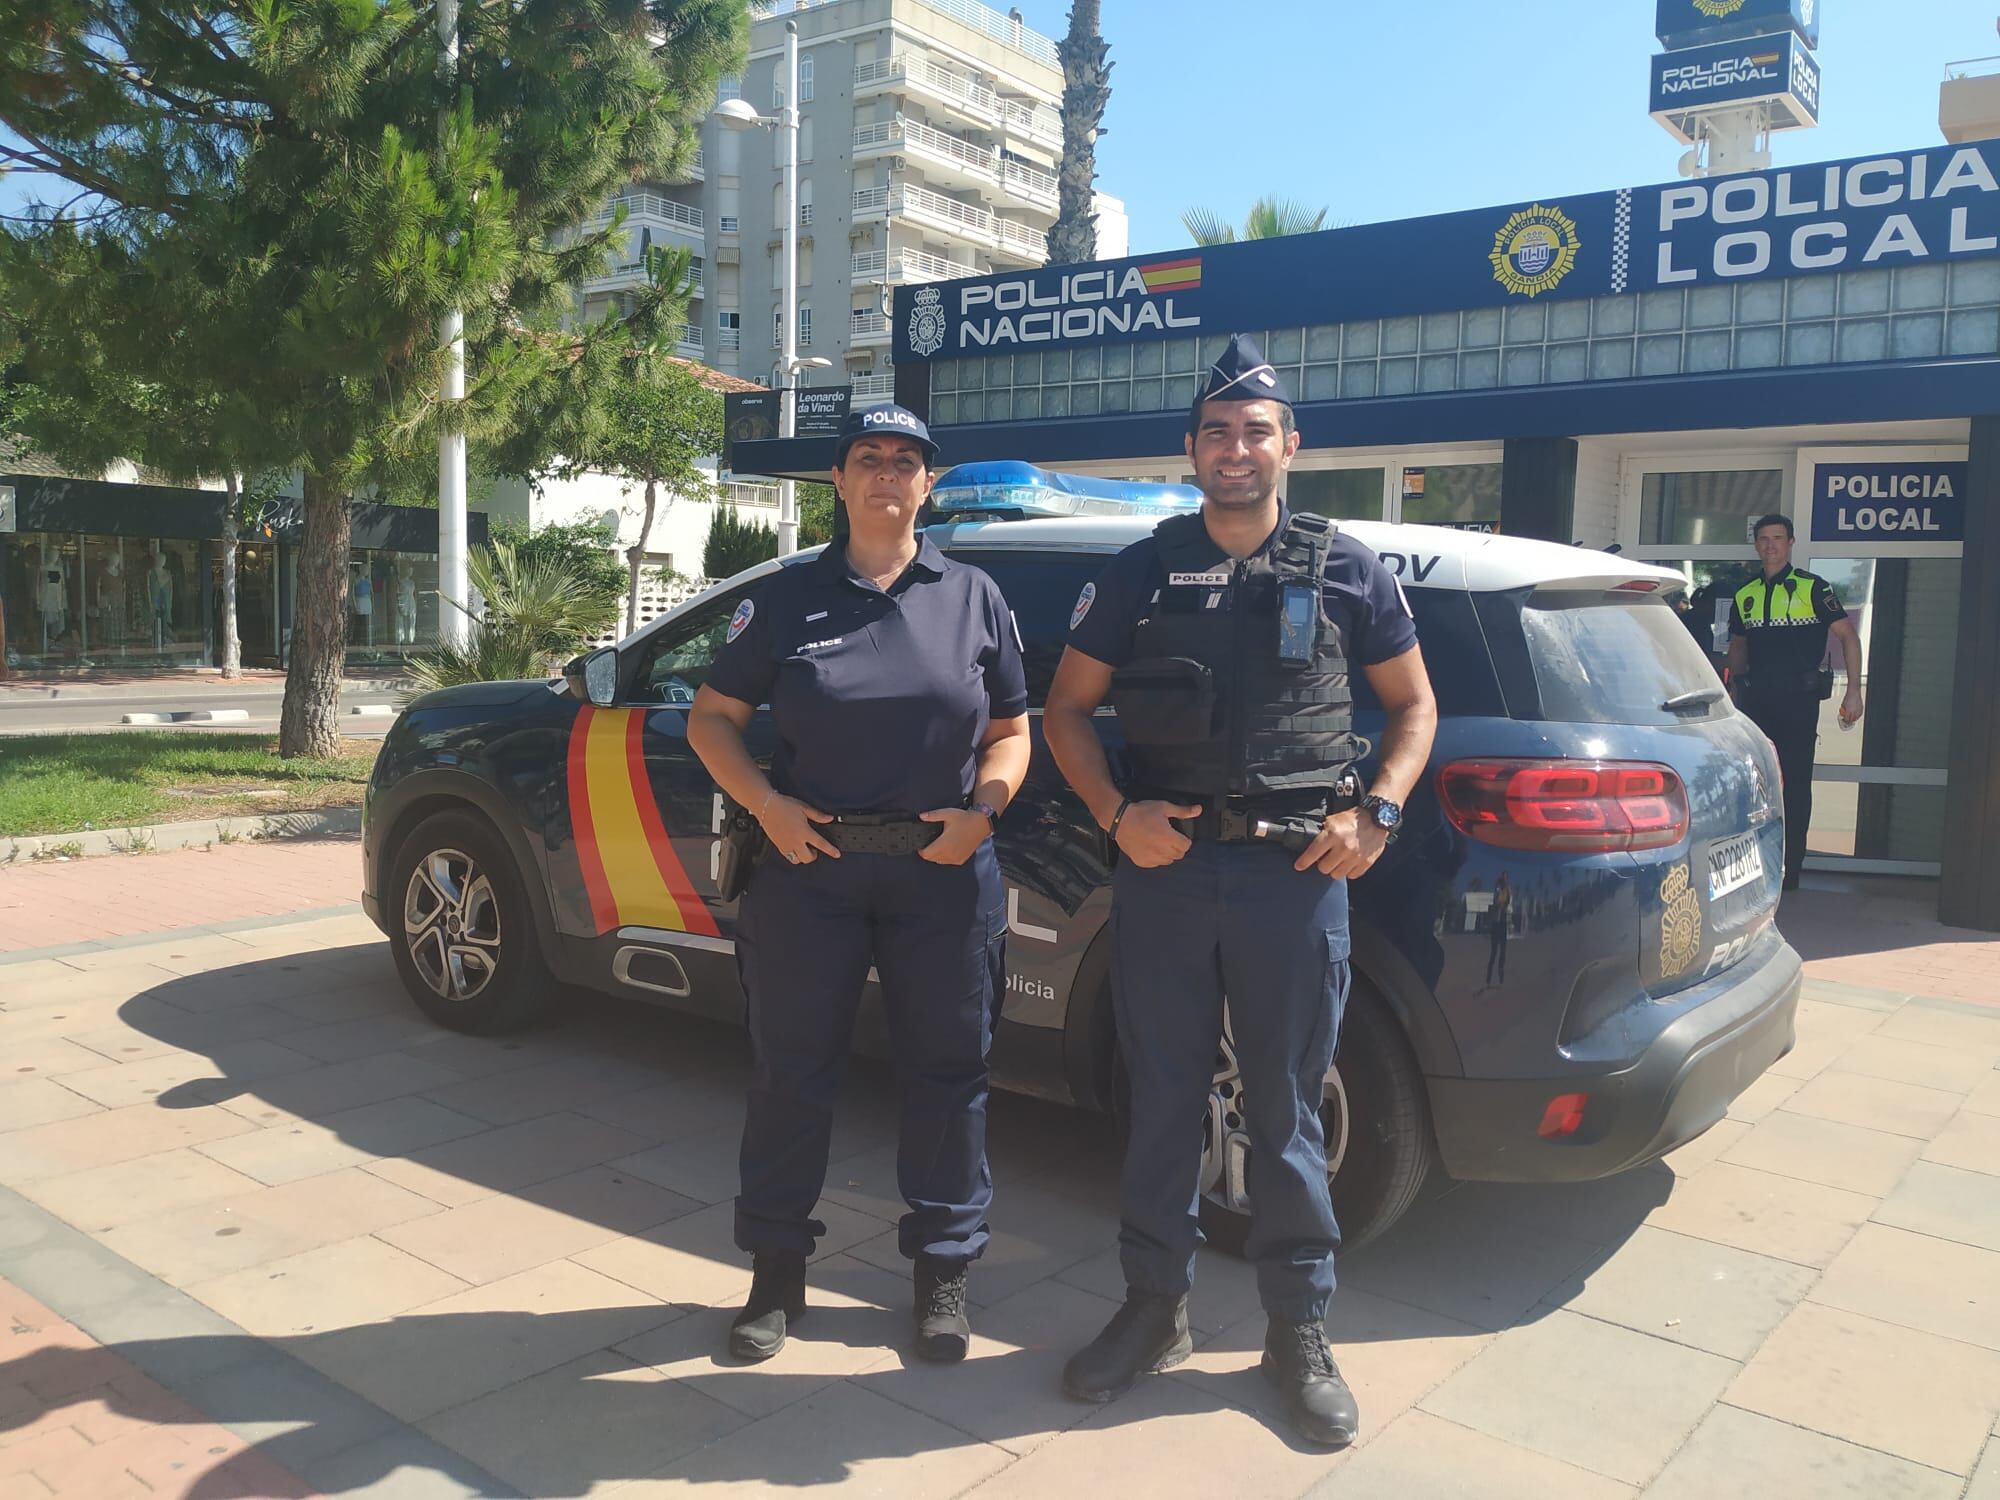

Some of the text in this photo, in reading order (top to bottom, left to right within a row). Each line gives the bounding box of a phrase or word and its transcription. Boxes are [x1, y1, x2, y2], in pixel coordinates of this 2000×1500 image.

[1661, 66, 1778, 95] NACIONAL
[1793, 52, 1818, 92] POLICIA
[1792, 68, 1817, 110] LOCAL
[1658, 147, 2000, 232] POLICIA
[1504, 217, 1565, 246] POLICIA LOCAL
[1657, 206, 1998, 285] LOCAL
[1509, 266, 1557, 284] GANDIA
[959, 298, 1200, 348] NACIONAL
[797, 402, 836, 413] da Vinci
[798, 391, 845, 403] Leonardo
[863, 411, 917, 430] POLICE
[1826, 474, 1955, 498] POLICIA
[1837, 507, 1941, 531] LOCAL
[797, 638, 843, 654] POLICE
